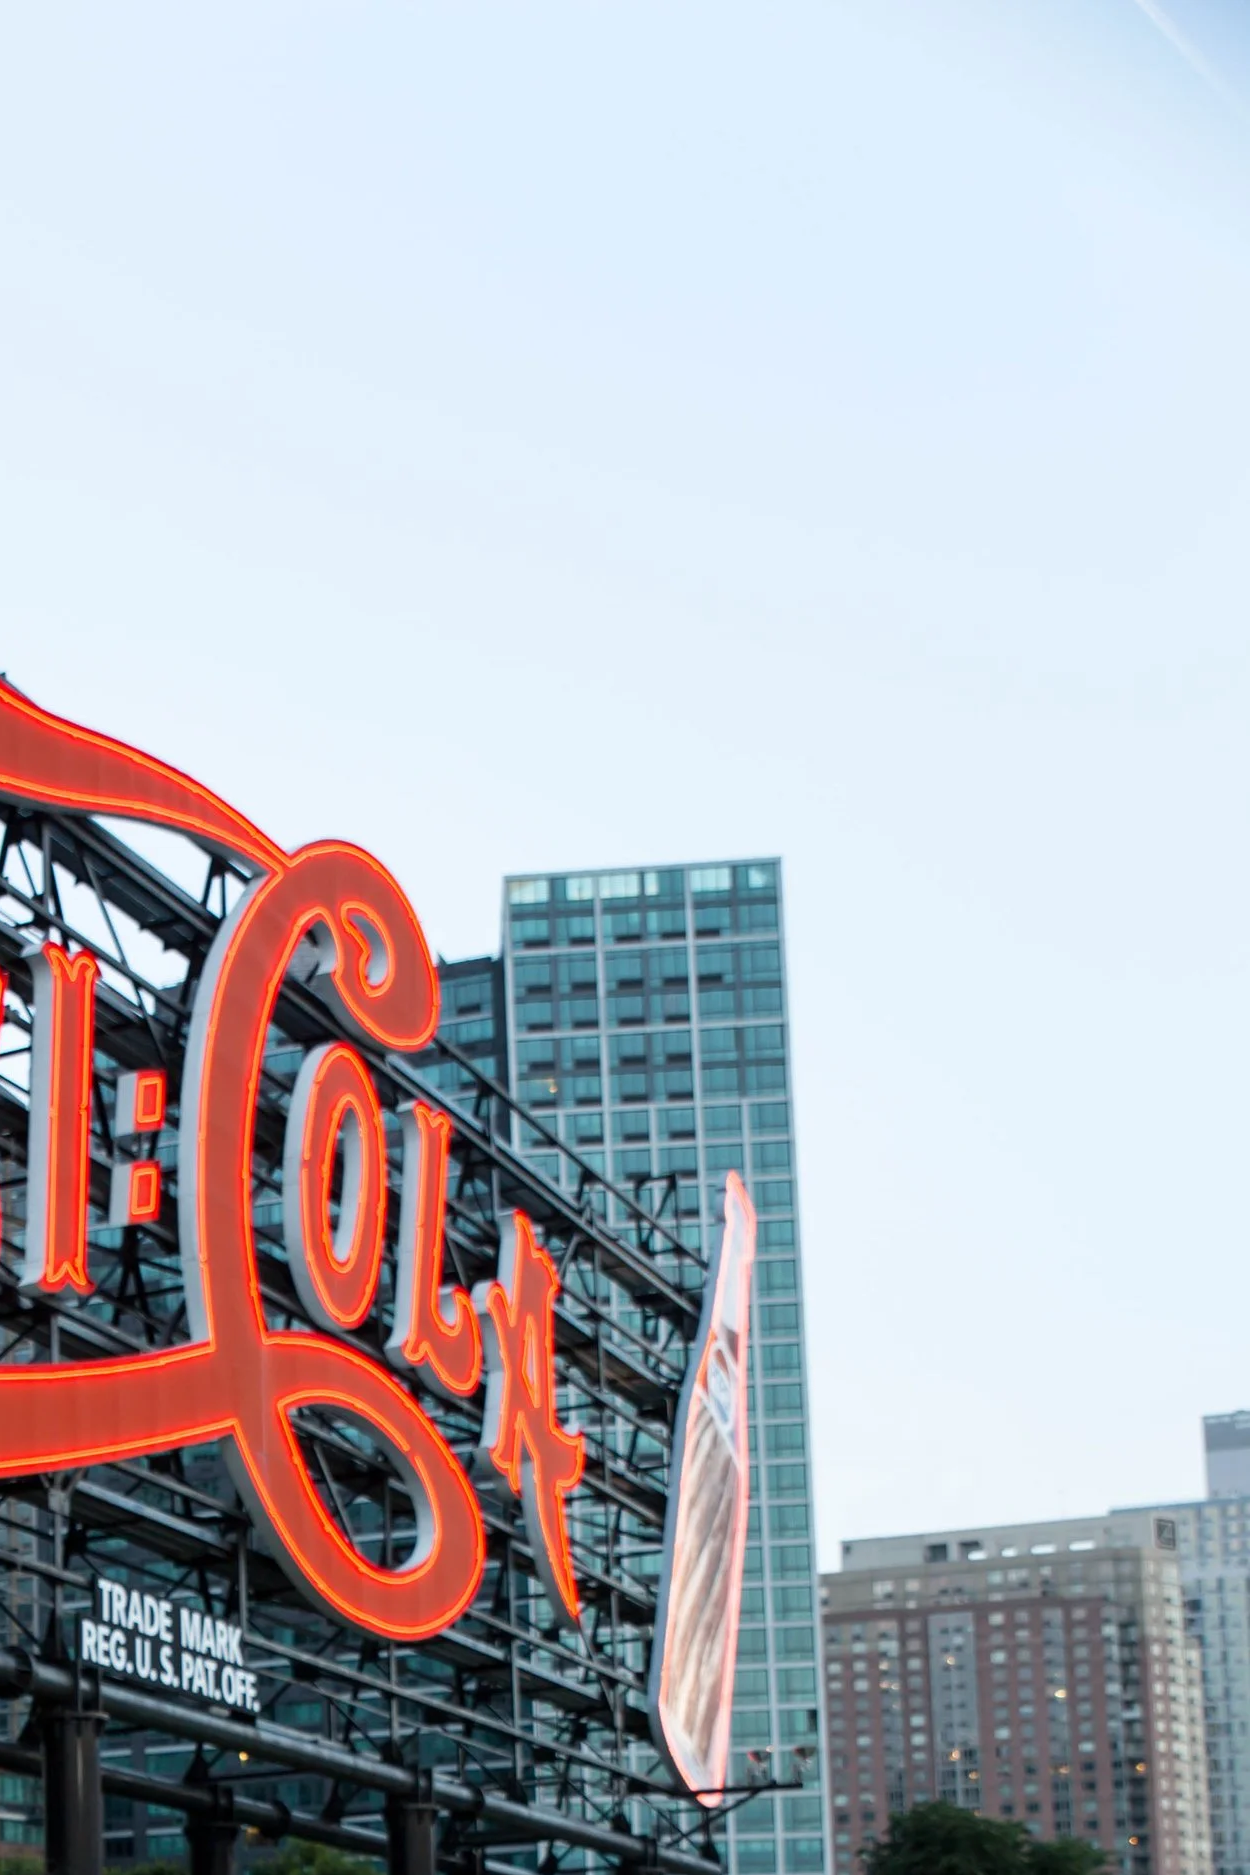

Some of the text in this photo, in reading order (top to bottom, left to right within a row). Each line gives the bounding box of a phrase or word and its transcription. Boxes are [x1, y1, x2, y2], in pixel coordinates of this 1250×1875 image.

[81, 1618, 135, 1675] REG.
[181, 1651, 222, 1701] PAT.
[221, 1664, 262, 1714] OFF.
[97, 1578, 244, 1667] TRADE MARK
